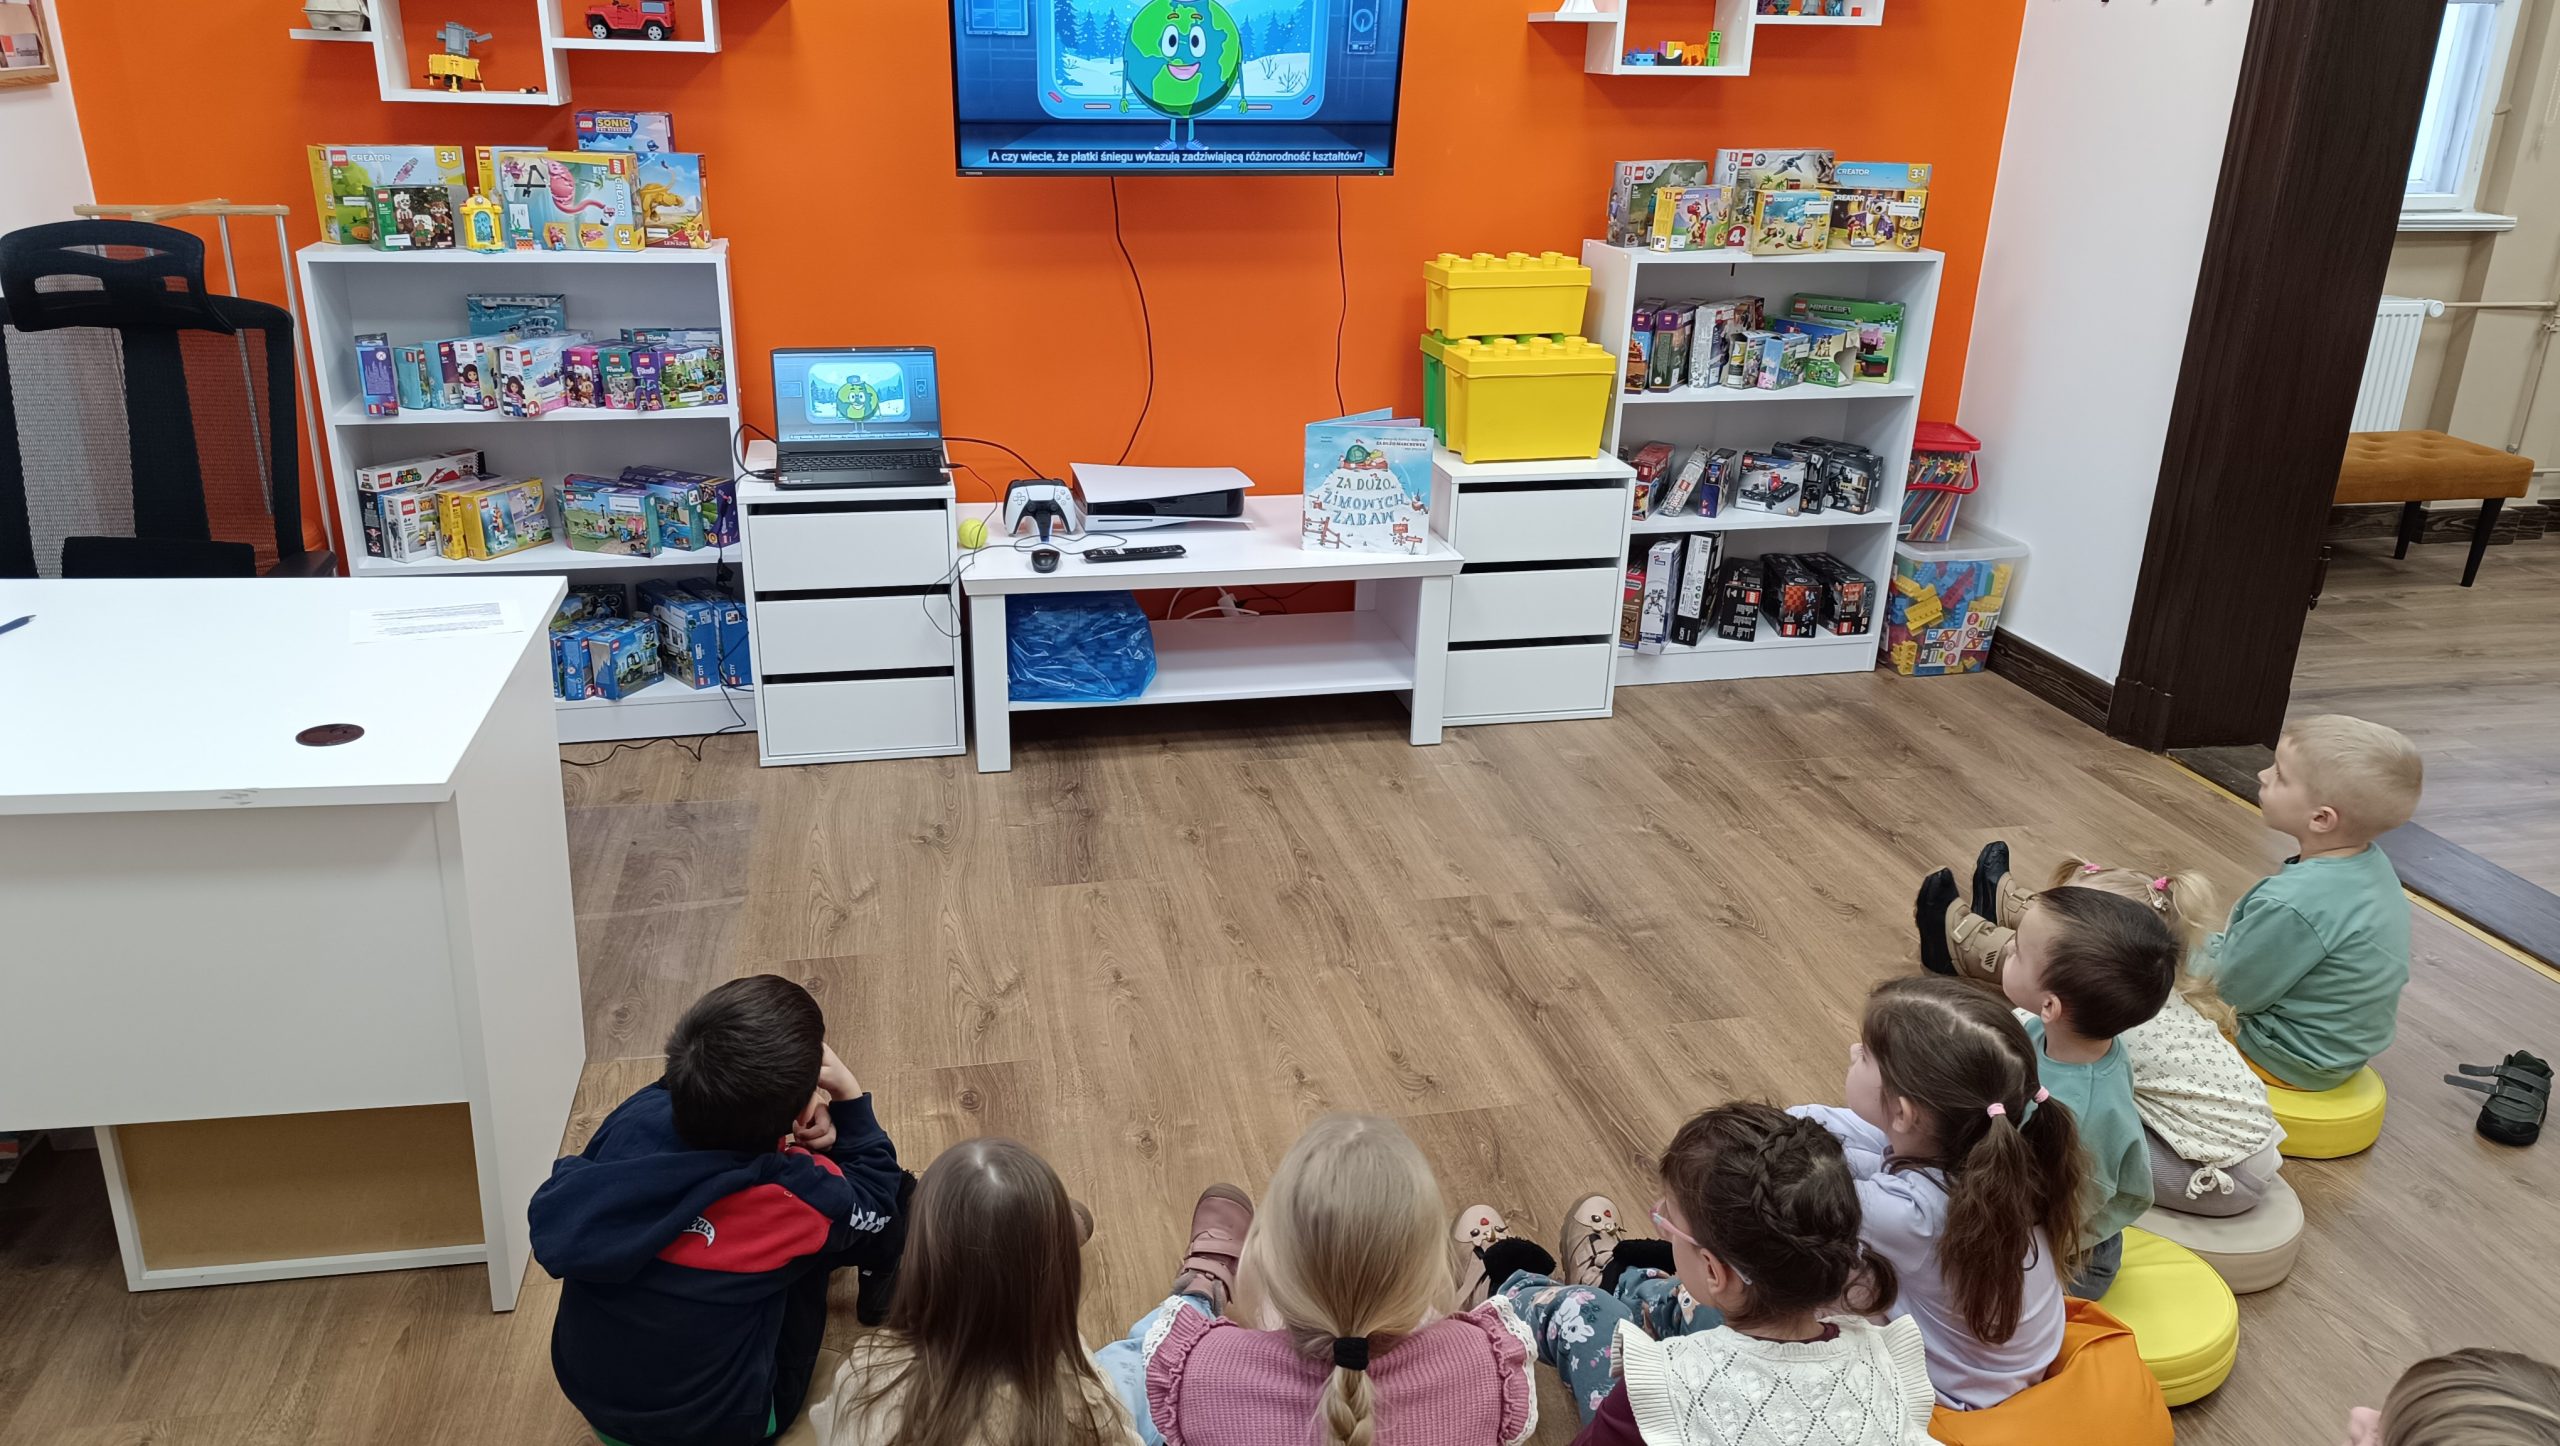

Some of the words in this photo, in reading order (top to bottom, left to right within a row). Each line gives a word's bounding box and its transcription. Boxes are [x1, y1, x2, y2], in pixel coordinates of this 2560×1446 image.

[597, 118, 630, 127] SONIC
[351, 154, 391, 162] CREATOR
[991, 152, 999, 161] A
[1001, 153, 1018, 163] czy
[1020, 152, 1055, 163] wiecie,
[1057, 151, 1069, 161] że
[1071, 151, 1098, 163] płatki
[1100, 151, 1133, 163] śniegu
[1135, 151, 1180, 163] wykazują
[1182, 151, 1243, 163] zadziwiającą
[1245, 151, 1311, 162] różnorodność
[1313, 151, 1362, 162] kształtów?
[615, 177, 625, 217] CREATOR
[1336, 477, 1352, 489] ZA
[1332, 510, 1395, 526] ZABAW
